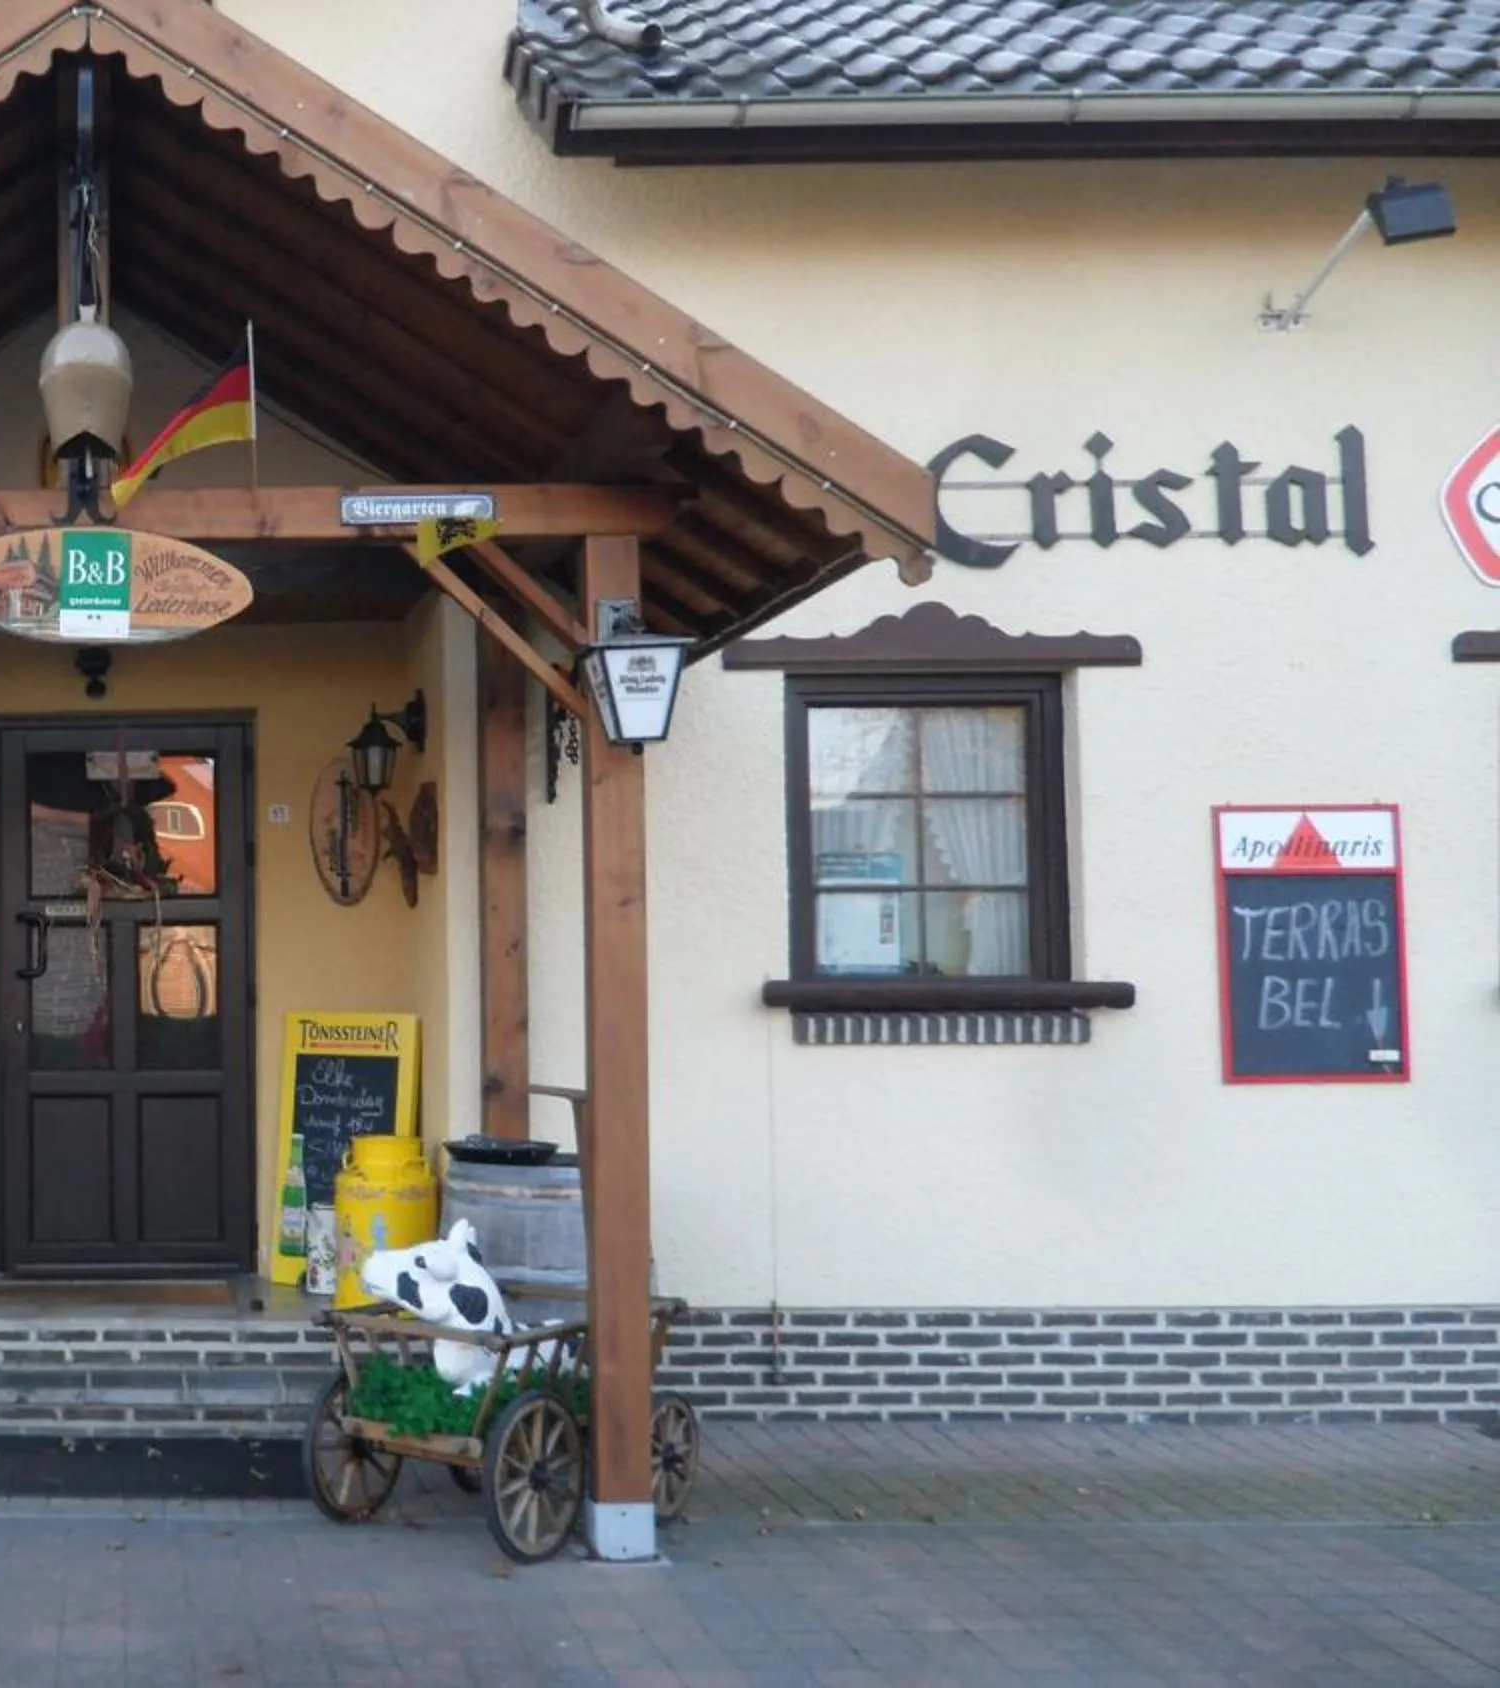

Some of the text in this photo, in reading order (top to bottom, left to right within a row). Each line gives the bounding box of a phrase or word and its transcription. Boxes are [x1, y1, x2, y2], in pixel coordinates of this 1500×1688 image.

[351, 500, 447, 518] Biergarten
[926, 424, 1376, 569] Cristal
[68, 549, 126, 585] B&B
[1232, 835, 1383, 863] Apollinaris
[1232, 899, 1389, 961] TERRAS
[1258, 975, 1342, 1030] BEL
